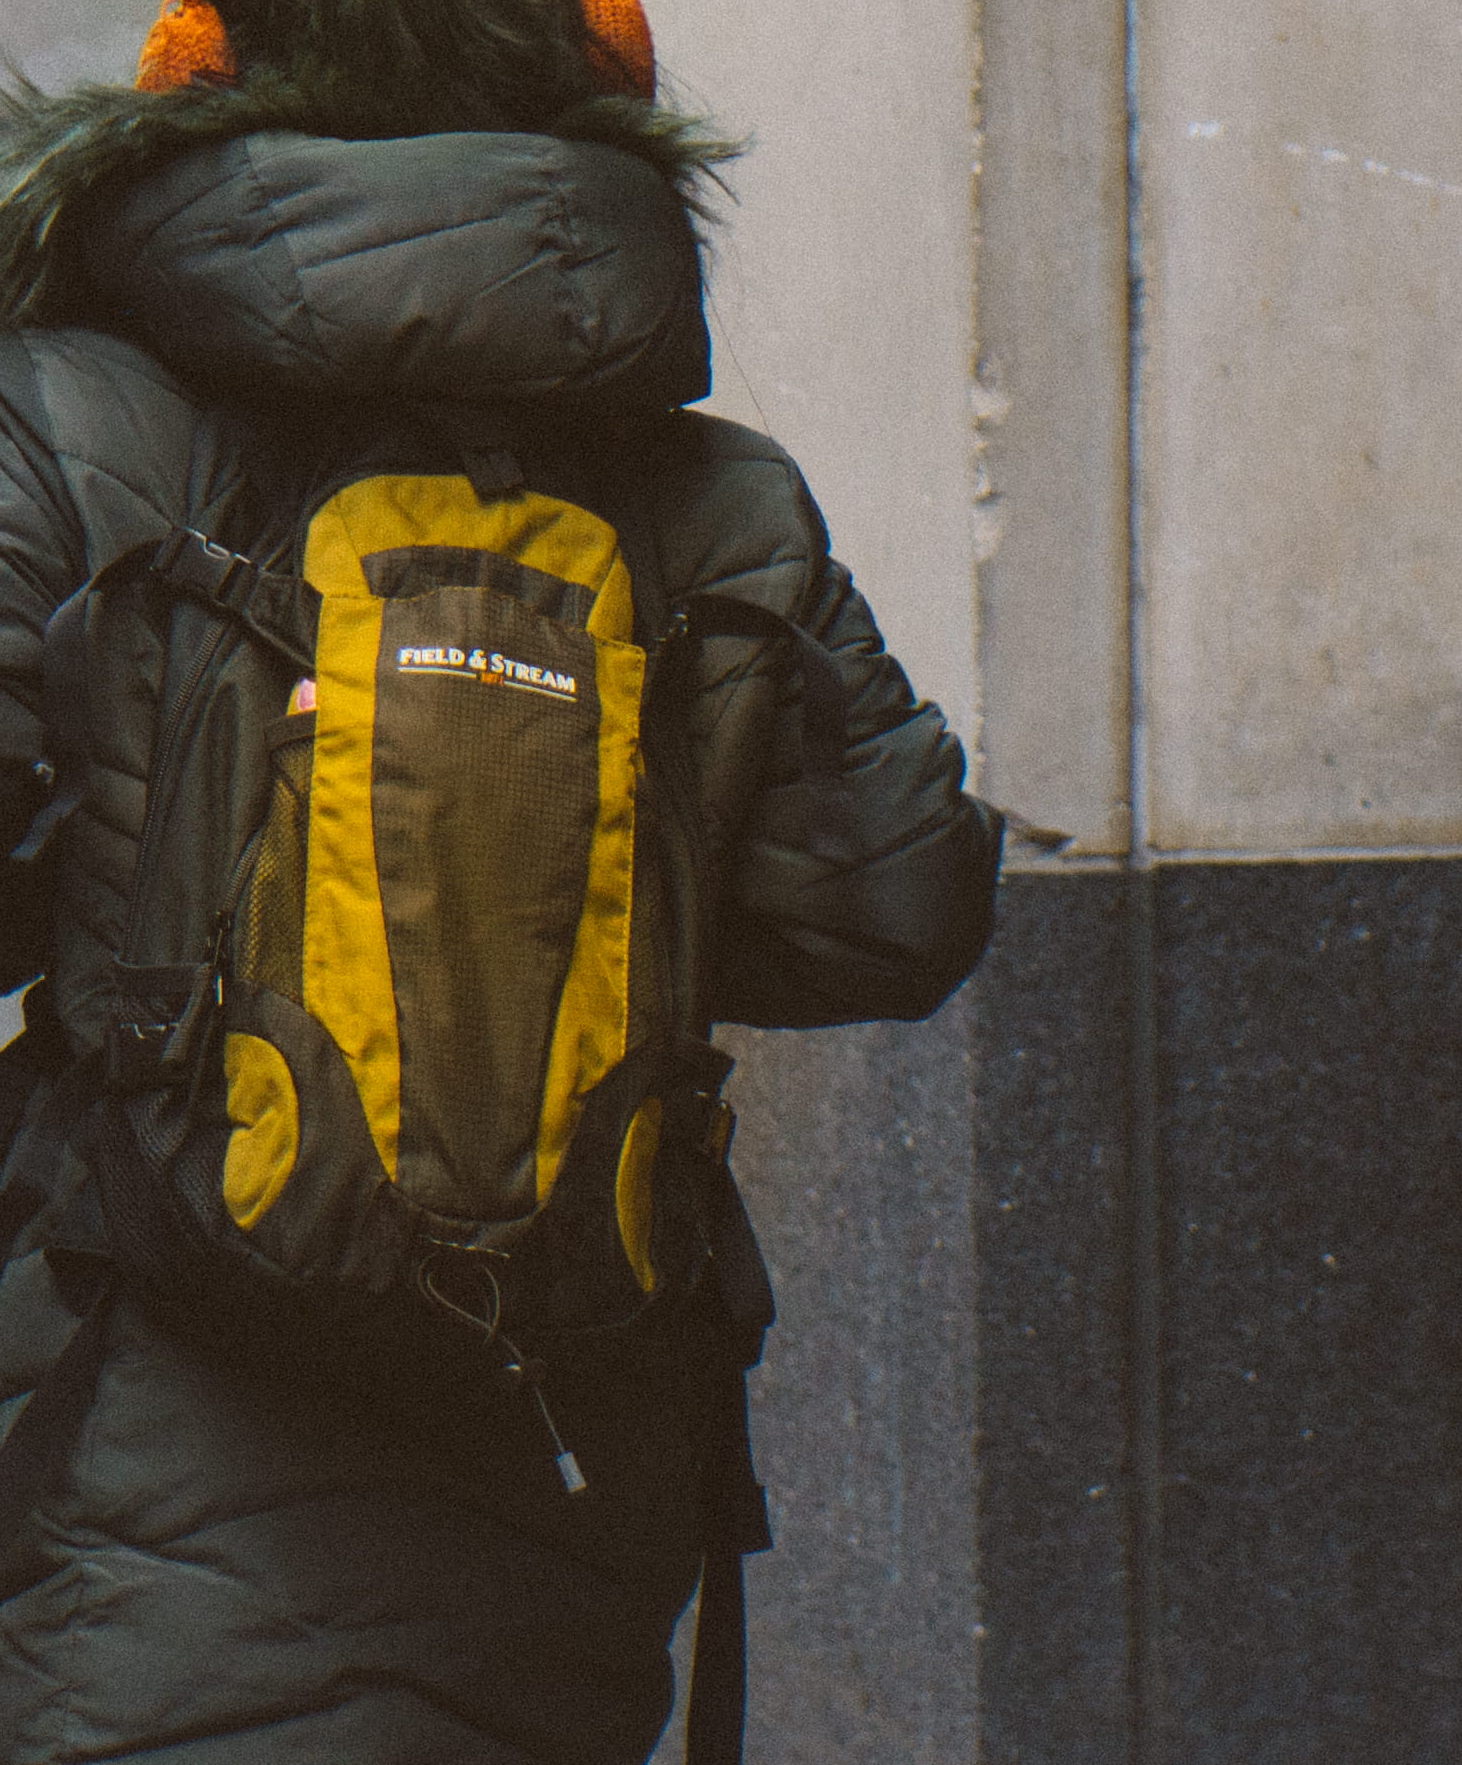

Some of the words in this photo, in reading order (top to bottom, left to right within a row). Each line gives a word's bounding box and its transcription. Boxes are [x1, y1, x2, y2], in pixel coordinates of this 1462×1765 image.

[398, 647, 465, 666] FIELD
[468, 649, 487, 670] &
[491, 653, 576, 693] STREAM
